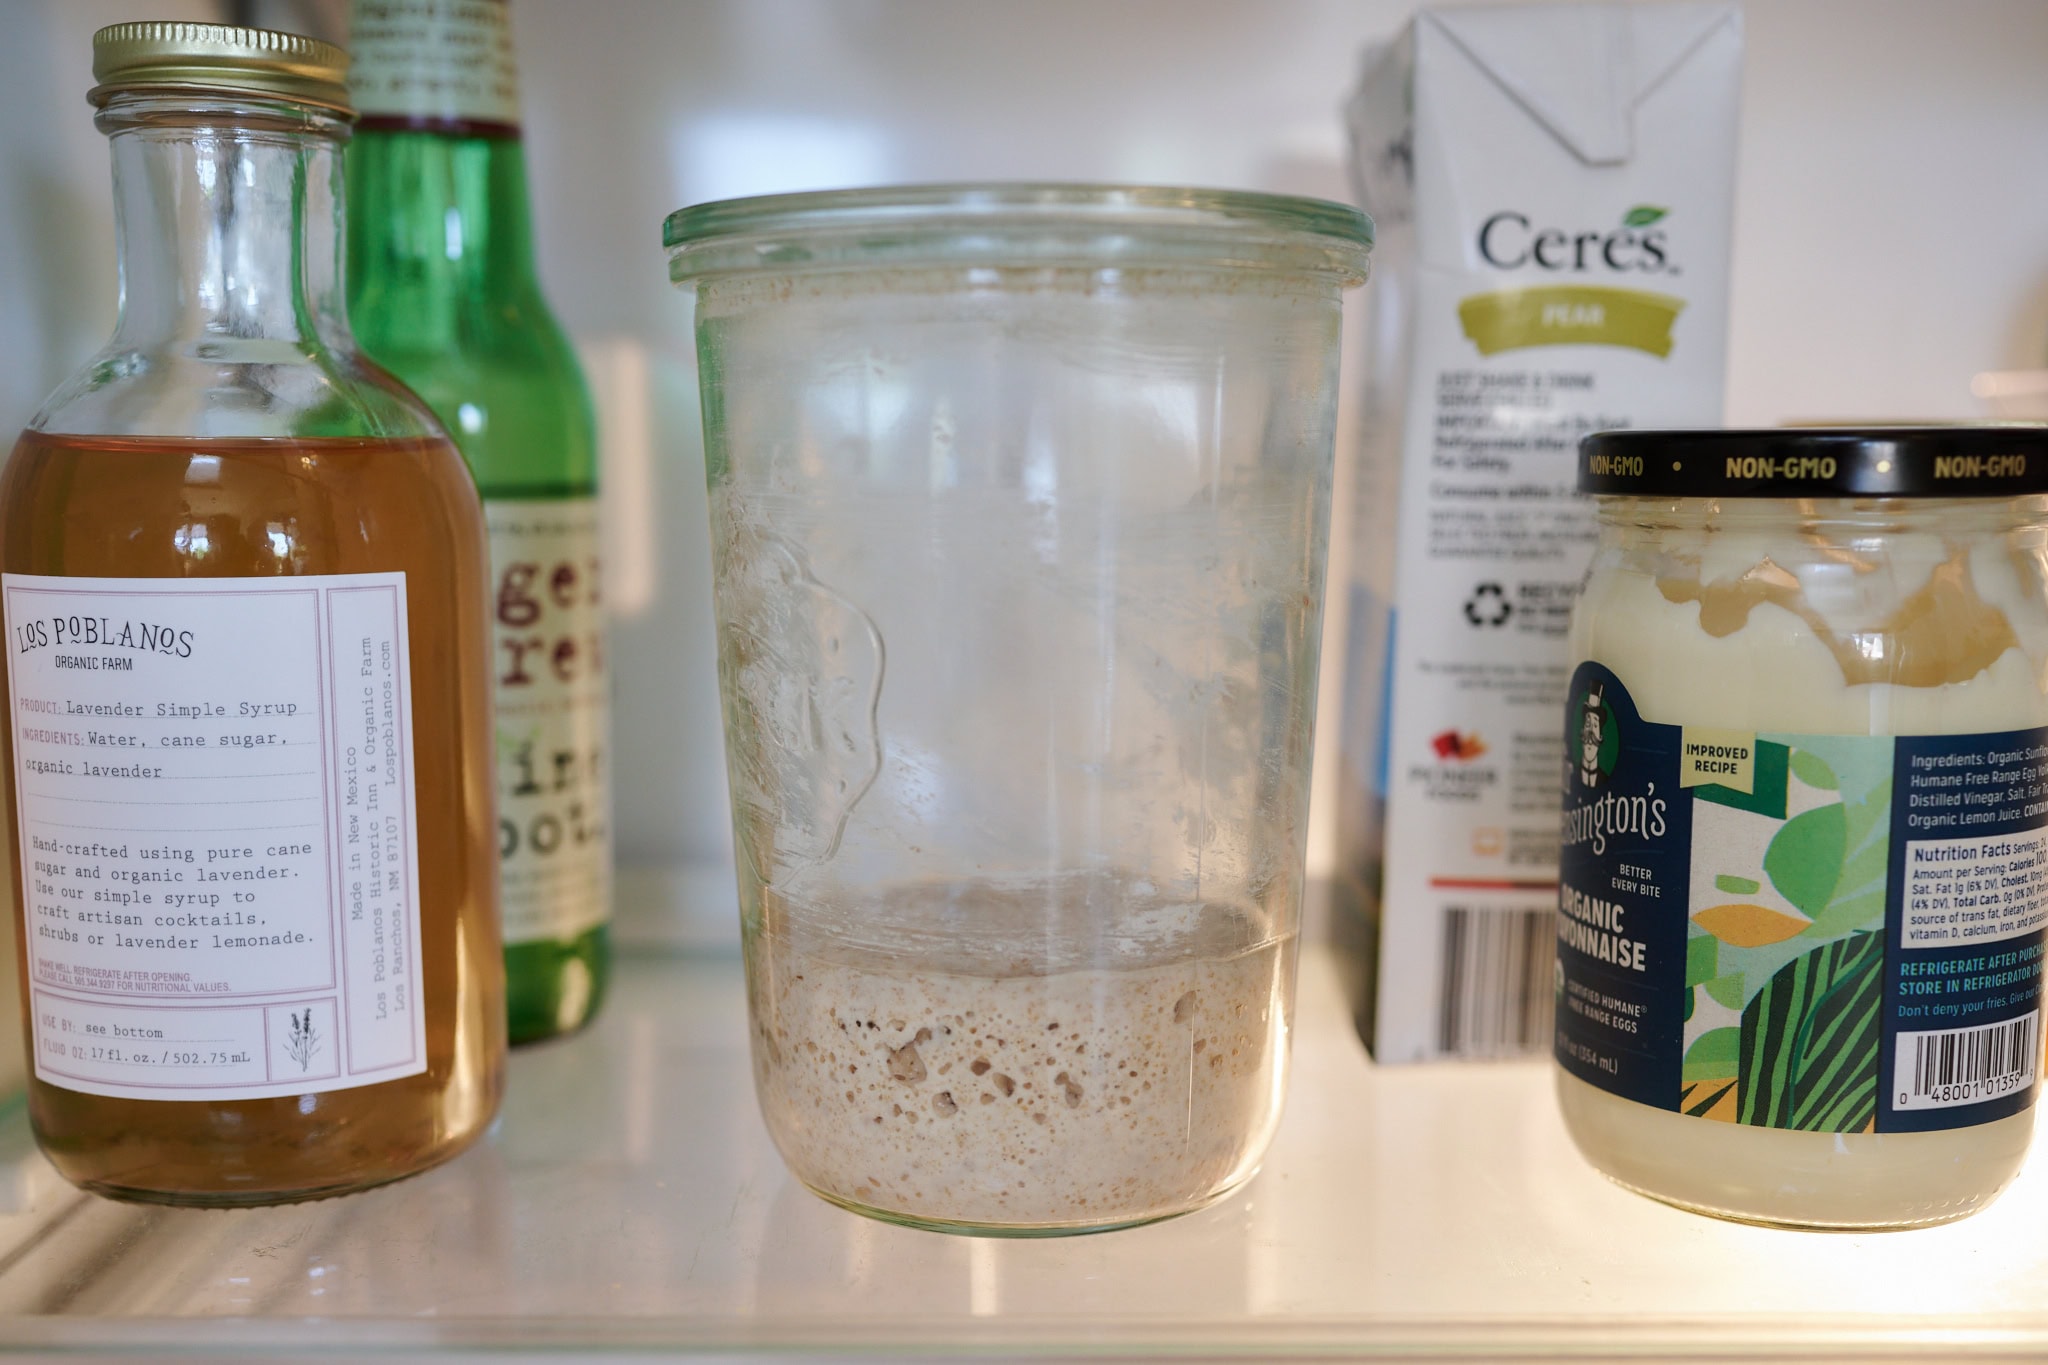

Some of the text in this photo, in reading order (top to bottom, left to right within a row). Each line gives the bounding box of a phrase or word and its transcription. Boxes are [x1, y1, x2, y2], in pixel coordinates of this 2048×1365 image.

[1477, 210, 1667, 273] Ceres
[1542, 302, 1606, 329] PEAR
[1590, 455, 2027, 480] NON-GMO NON-GMO NON-GMO
[17, 616, 195, 658] LOS POBLANOS
[55, 655, 133, 671] ORGANIC FARM
[20, 698, 297, 719] PRODUCT: Lavender Simple Syrup
[22, 727, 287, 749] INGREDIENTS: Water, cane sugar,
[1686, 743, 1749, 760] IMPROVED
[1911, 749, 2024, 771] Ingredients: Organic
[25, 758, 162, 778] organic lavender
[1695, 759, 1738, 775] RECIPE
[1910, 767, 2037, 788] Humane Free Range Egg
[1909, 792, 1961, 808] Distilled
[2028, 783, 2042, 798] Fair
[361, 636, 387, 1021] Los Poblanos Historic Inn & Organic Farm
[380, 640, 406, 1013] Los Ranchos, NM 87107 Lospoblanos.com
[1908, 812, 1957, 830] Organic
[1960, 812, 1995, 825] Lemon
[344, 746, 363, 922] Made in New Mexico
[33, 836, 312, 863] Hand-crafted using pure cane
[1915, 845, 1977, 862] Nutrition
[1981, 842, 2011, 859] Facts
[34, 860, 299, 885] sugar and organic lavender.
[1619, 863, 1652, 881] BETTER
[1912, 868, 1953, 880] Amount
[1956, 869, 1971, 881] per
[1974, 864, 2007, 877] Serving:
[2008, 857, 2035, 873] Calories
[35, 879, 255, 908] Use our simple syrup to
[1611, 877, 1661, 898] EVERY BITE
[1912, 884, 1932, 896] Sat.
[1936, 883, 1952, 894] Fat
[1967, 880, 1982, 894] (6%
[37, 903, 266, 927] craft artisan cocktails,
[1910, 915, 1946, 926] source
[1949, 912, 1959, 923] of
[1961, 910, 1985, 923] trans
[1988, 908, 2001, 920] fat,
[2003, 903, 2026, 918] dietary
[1911, 899, 1928, 911] (4%
[1953, 896, 1977, 908] Total
[39, 923, 313, 949] shrubs or lavender lemonade.
[1910, 928, 1948, 940] vitamin
[1951, 927, 1961, 939] D,
[1963, 924, 1998, 937] calcium,
[2016, 916, 2028, 929] and
[73, 965, 193, 983] REFRIGERATE AFTER OPENING.
[1901, 951, 2017, 976] REFRIGERATE AFTER
[117, 981, 133, 991] FOR
[135, 982, 191, 993] NUTRITIONAL
[193, 982, 232, 993] VALUES.
[1899, 981, 1942, 996] STORE
[1946, 980, 1960, 993] IN
[1963, 965, 2031, 993] REFRIGERATOR
[1898, 1004, 1929, 1018] Don't
[1932, 1003, 1960, 1017] deny
[1962, 1001, 1985, 1015] your
[1987, 995, 2008, 1009] fries.
[2009, 991, 2024, 1004] Give
[2025, 989, 2034, 1000] our
[42, 1013, 163, 1039] USE BY: see bottom
[1584, 1004, 1638, 1034] RANGE EGGS
[43, 1038, 66, 1056] FLUID
[92, 1047, 104, 1058] 17
[174, 1052, 228, 1065] 502.75
[231, 1051, 251, 1063] mL
[1599, 1057, 1618, 1075] mL)
[1899, 1092, 1908, 1105] 0
[1931, 1082, 1979, 1103] 48001
[1986, 1072, 2021, 1095] 01359
